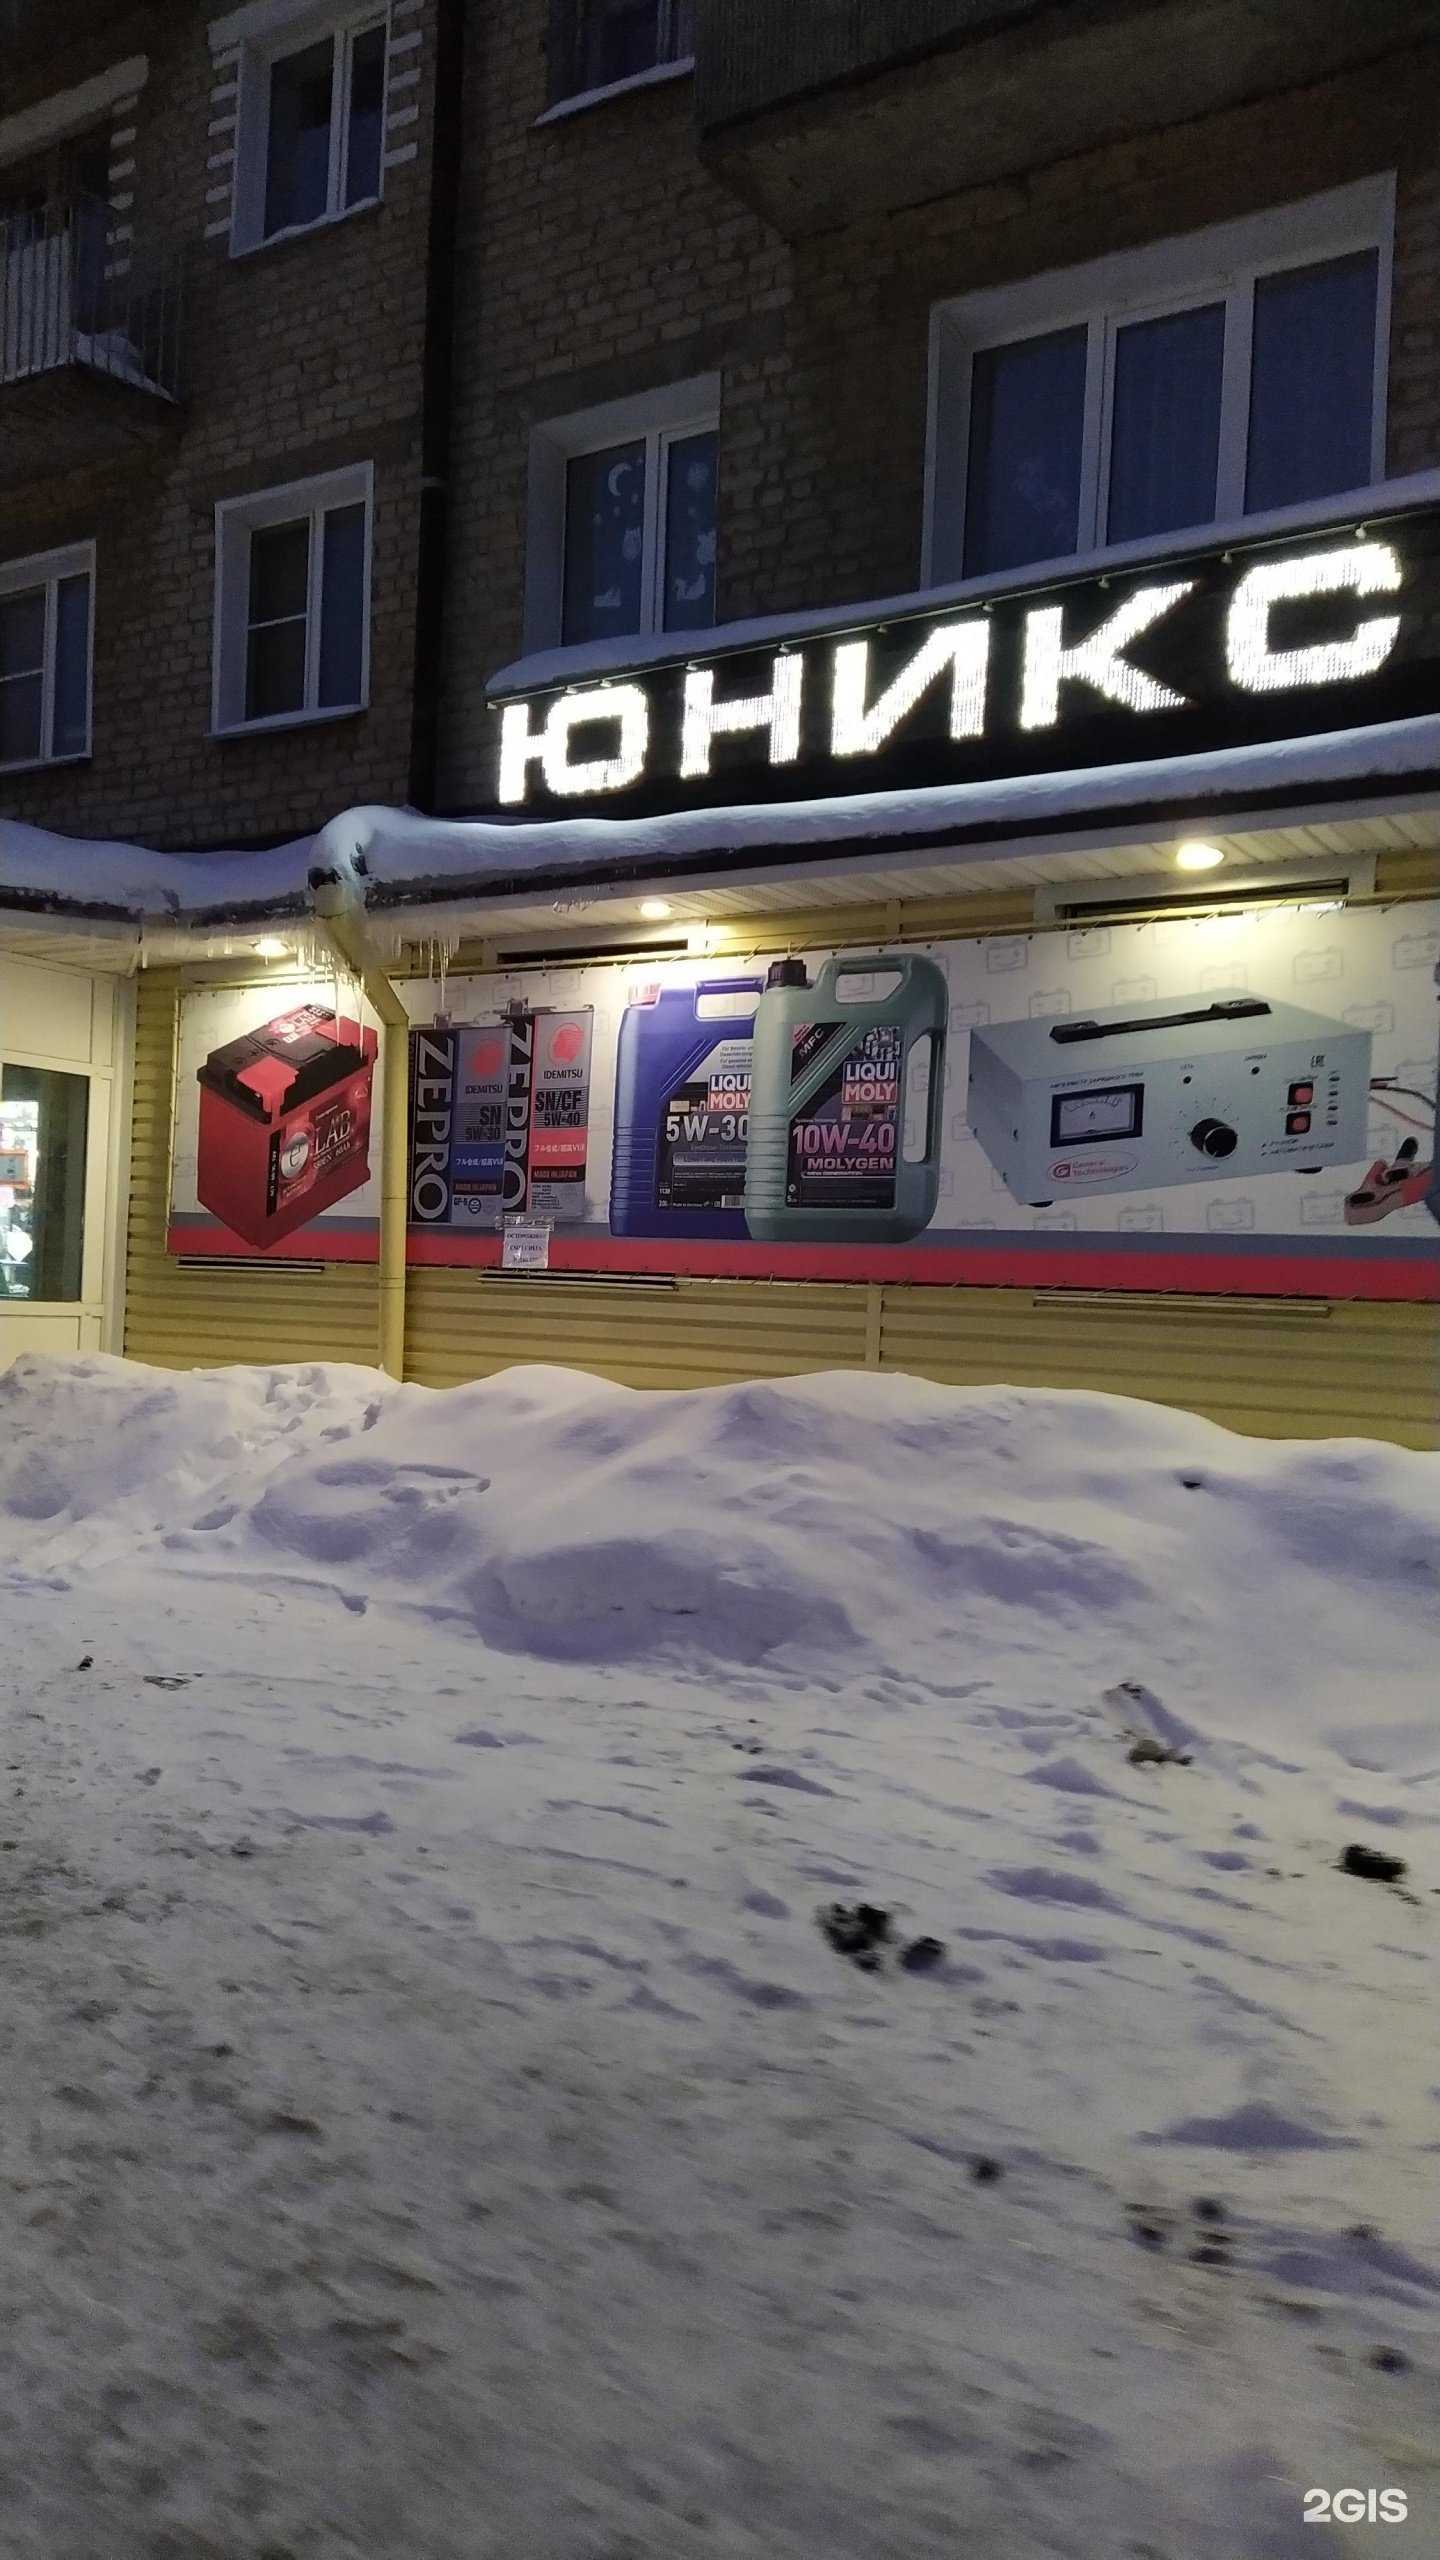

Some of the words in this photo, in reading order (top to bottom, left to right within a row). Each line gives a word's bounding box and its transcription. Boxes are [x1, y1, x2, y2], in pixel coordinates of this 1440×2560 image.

[496, 540, 1404, 805] ЮНИКС
[799, 1028, 824, 1057] MFC
[543, 1069, 584, 1080] IDEMITSU
[846, 1062, 895, 1081] LIQUI
[465, 1084, 503, 1095] IDEMITSU
[845, 1083, 895, 1101] MOLY
[535, 1090, 583, 1112] SN/CF
[710, 1093, 752, 1109] MOLY
[479, 1105, 502, 1126] SN
[543, 1111, 580, 1127] 5W-40
[412, 1035, 454, 1220] ZEPRO
[665, 1114, 750, 1142] 5W-30
[792, 1123, 896, 1154] 10W-40
[807, 1157, 894, 1170] MOLYGEN
